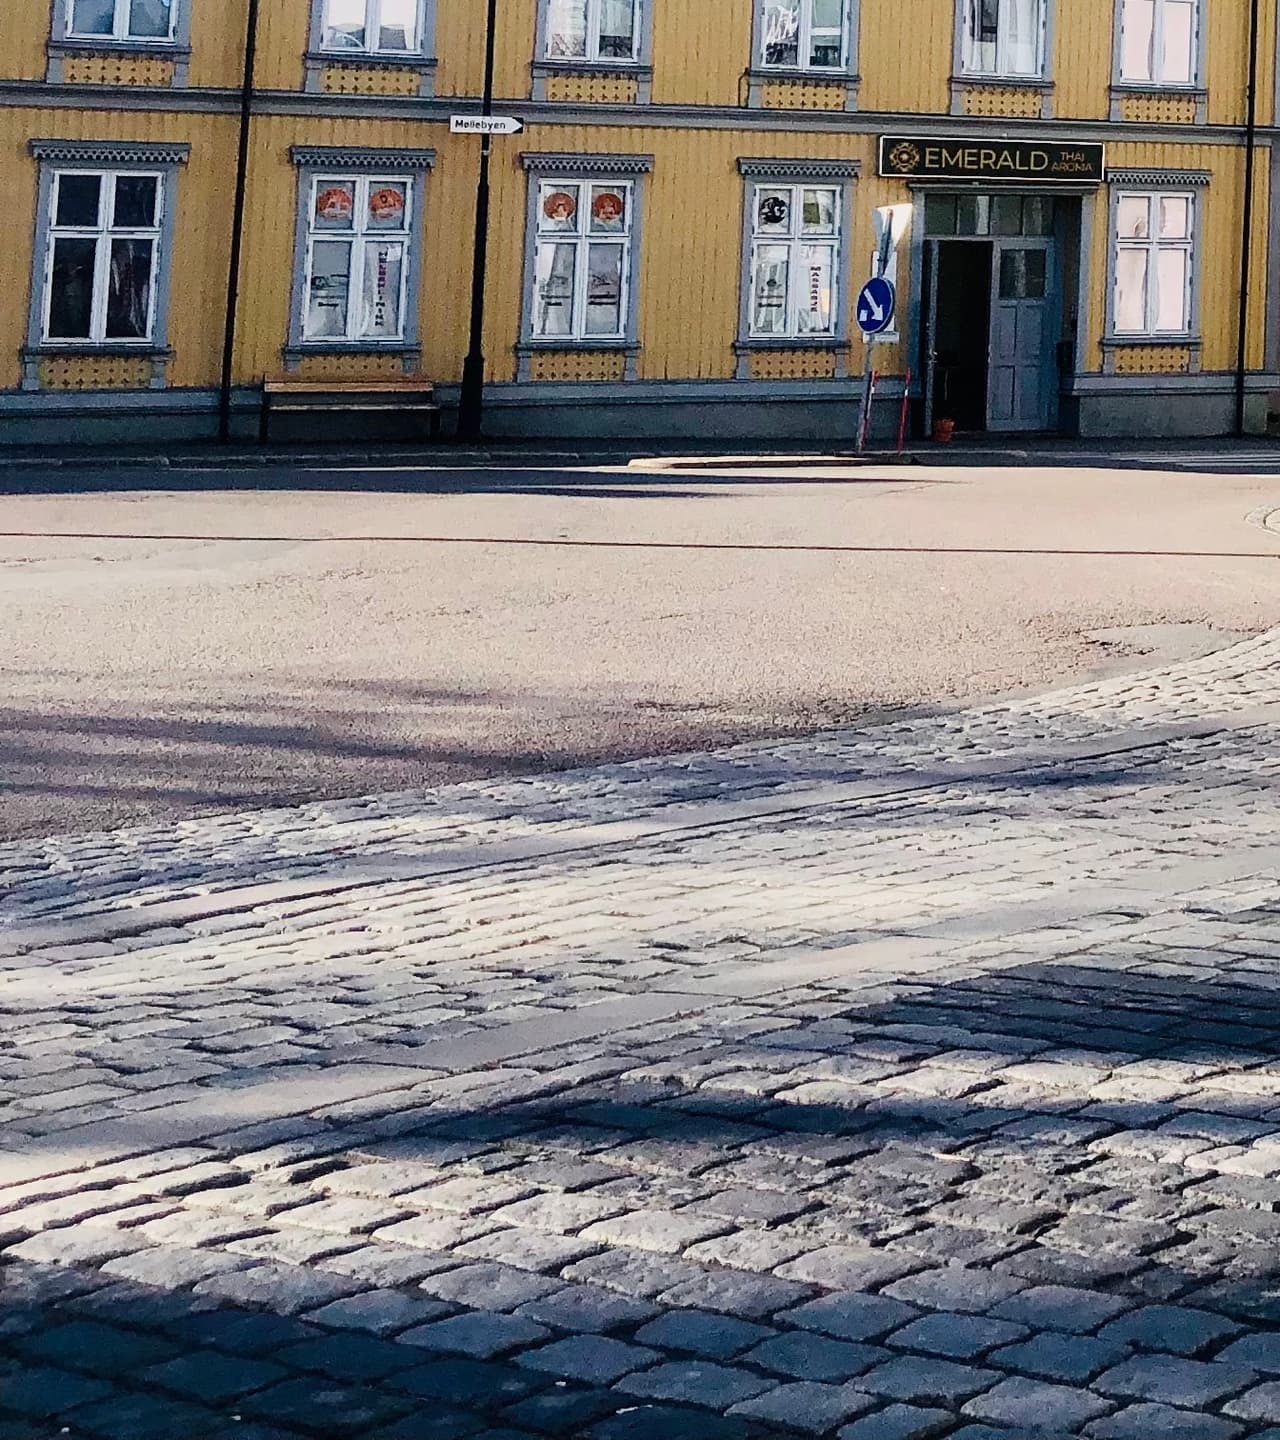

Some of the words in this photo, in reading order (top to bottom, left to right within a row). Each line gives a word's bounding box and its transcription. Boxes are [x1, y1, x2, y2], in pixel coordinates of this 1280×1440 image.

[455, 119, 506, 131] Møllebyen
[925, 147, 1048, 171] EMERALD
[1060, 151, 1085, 161] THAI
[1051, 162, 1093, 172] AROMA
